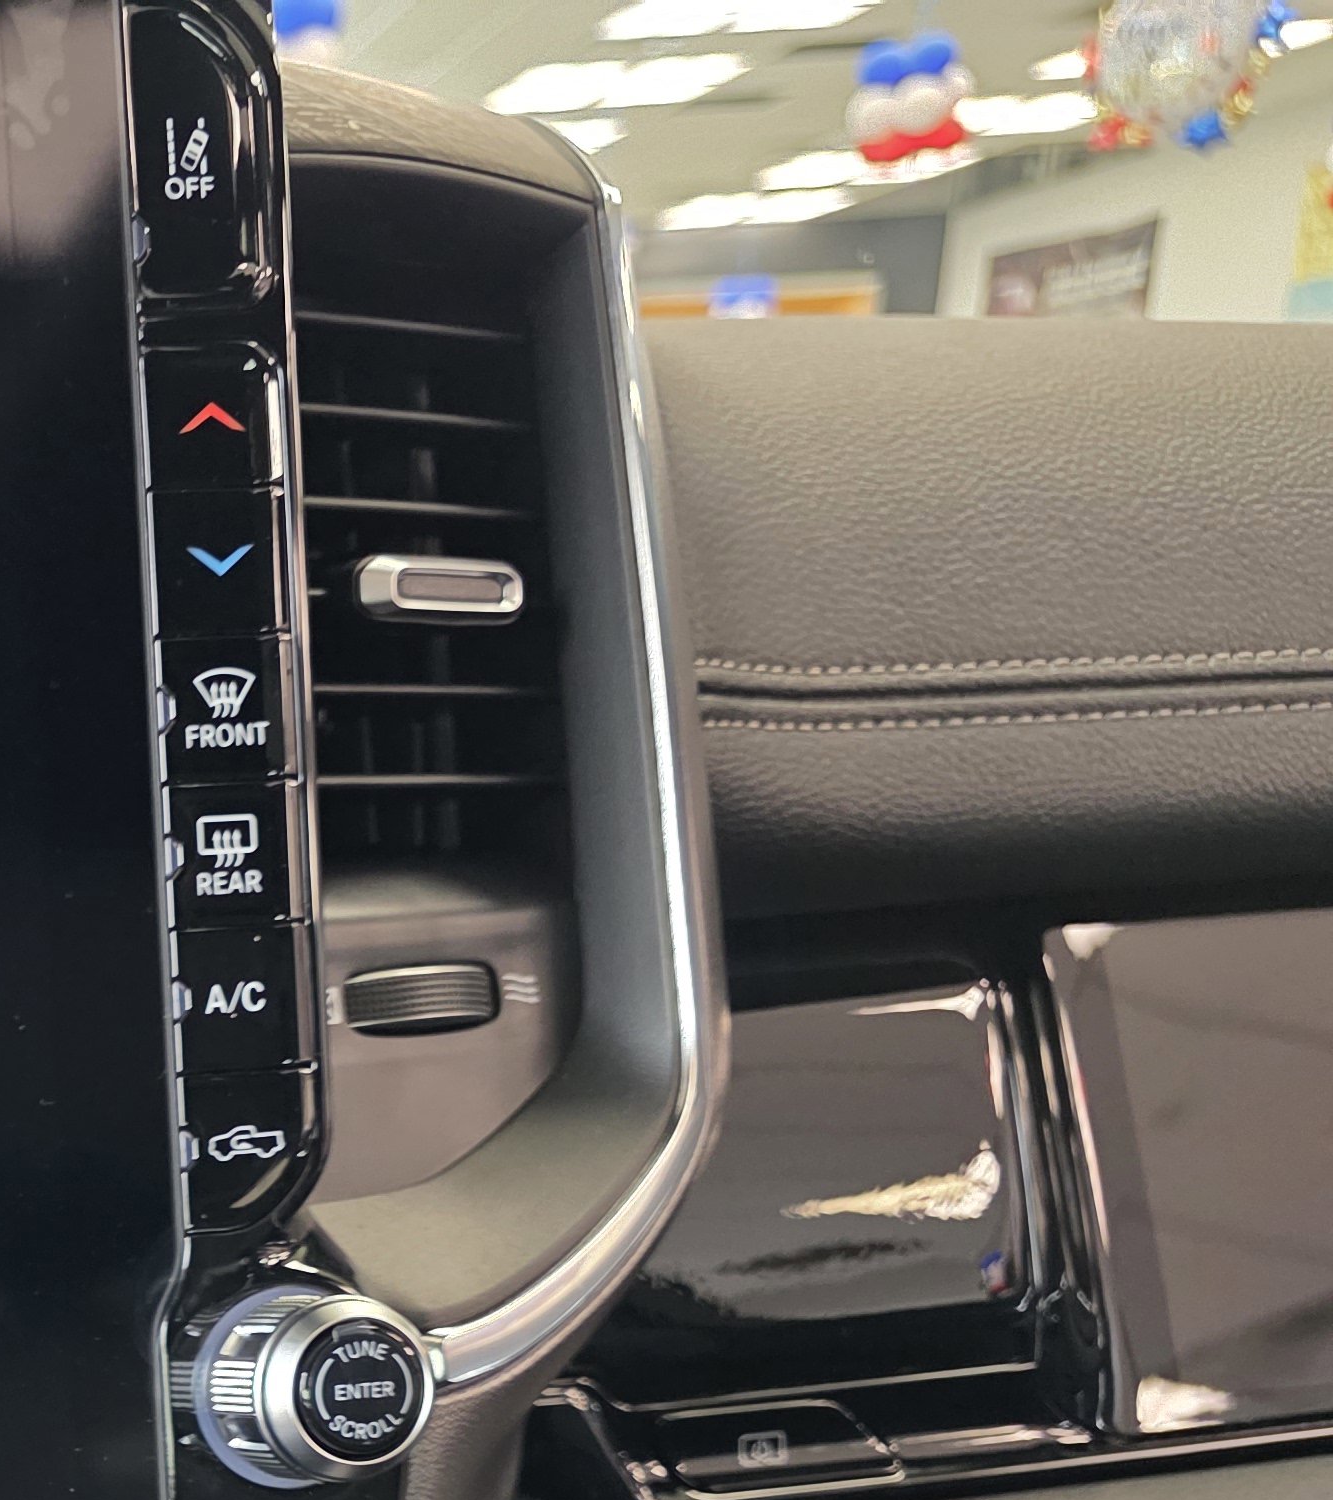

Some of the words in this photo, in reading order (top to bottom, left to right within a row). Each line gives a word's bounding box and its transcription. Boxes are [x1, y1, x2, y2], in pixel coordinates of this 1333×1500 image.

[165, 176, 215, 200] OFF
[185, 721, 270, 749] FRONT
[196, 868, 263, 896] REAR
[204, 981, 267, 1016] A/C
[333, 1339, 391, 1364] TUNE
[334, 1380, 397, 1401] ENTER
[329, 1413, 404, 1440] SCROLL
